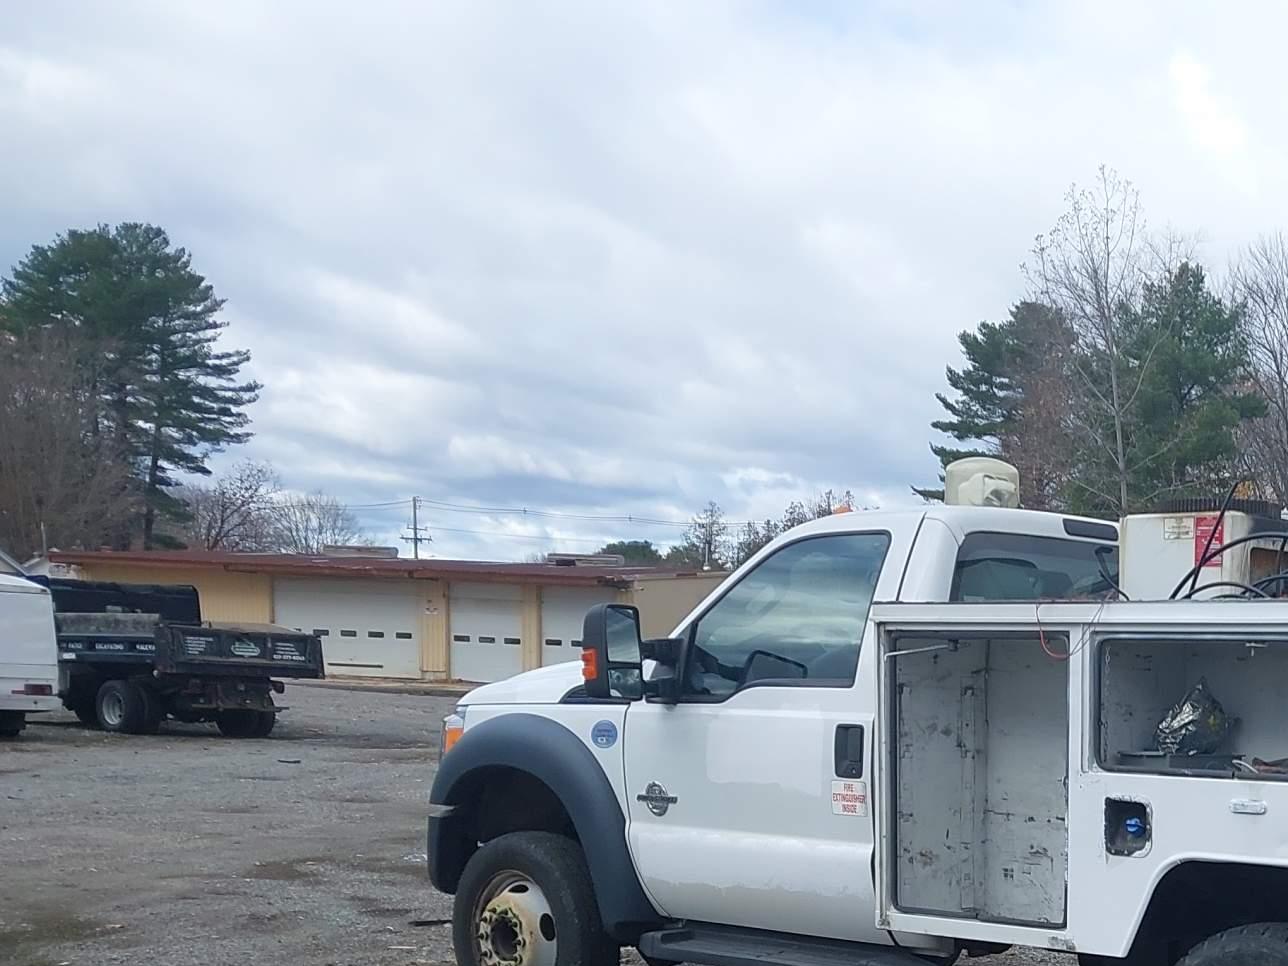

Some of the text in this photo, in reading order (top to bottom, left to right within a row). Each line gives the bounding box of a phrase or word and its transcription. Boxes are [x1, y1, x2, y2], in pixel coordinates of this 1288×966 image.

[843, 783, 854, 793] FIRE
[832, 793, 866, 804] EXTINGUISHER
[841, 804, 857, 813] INSIDE
